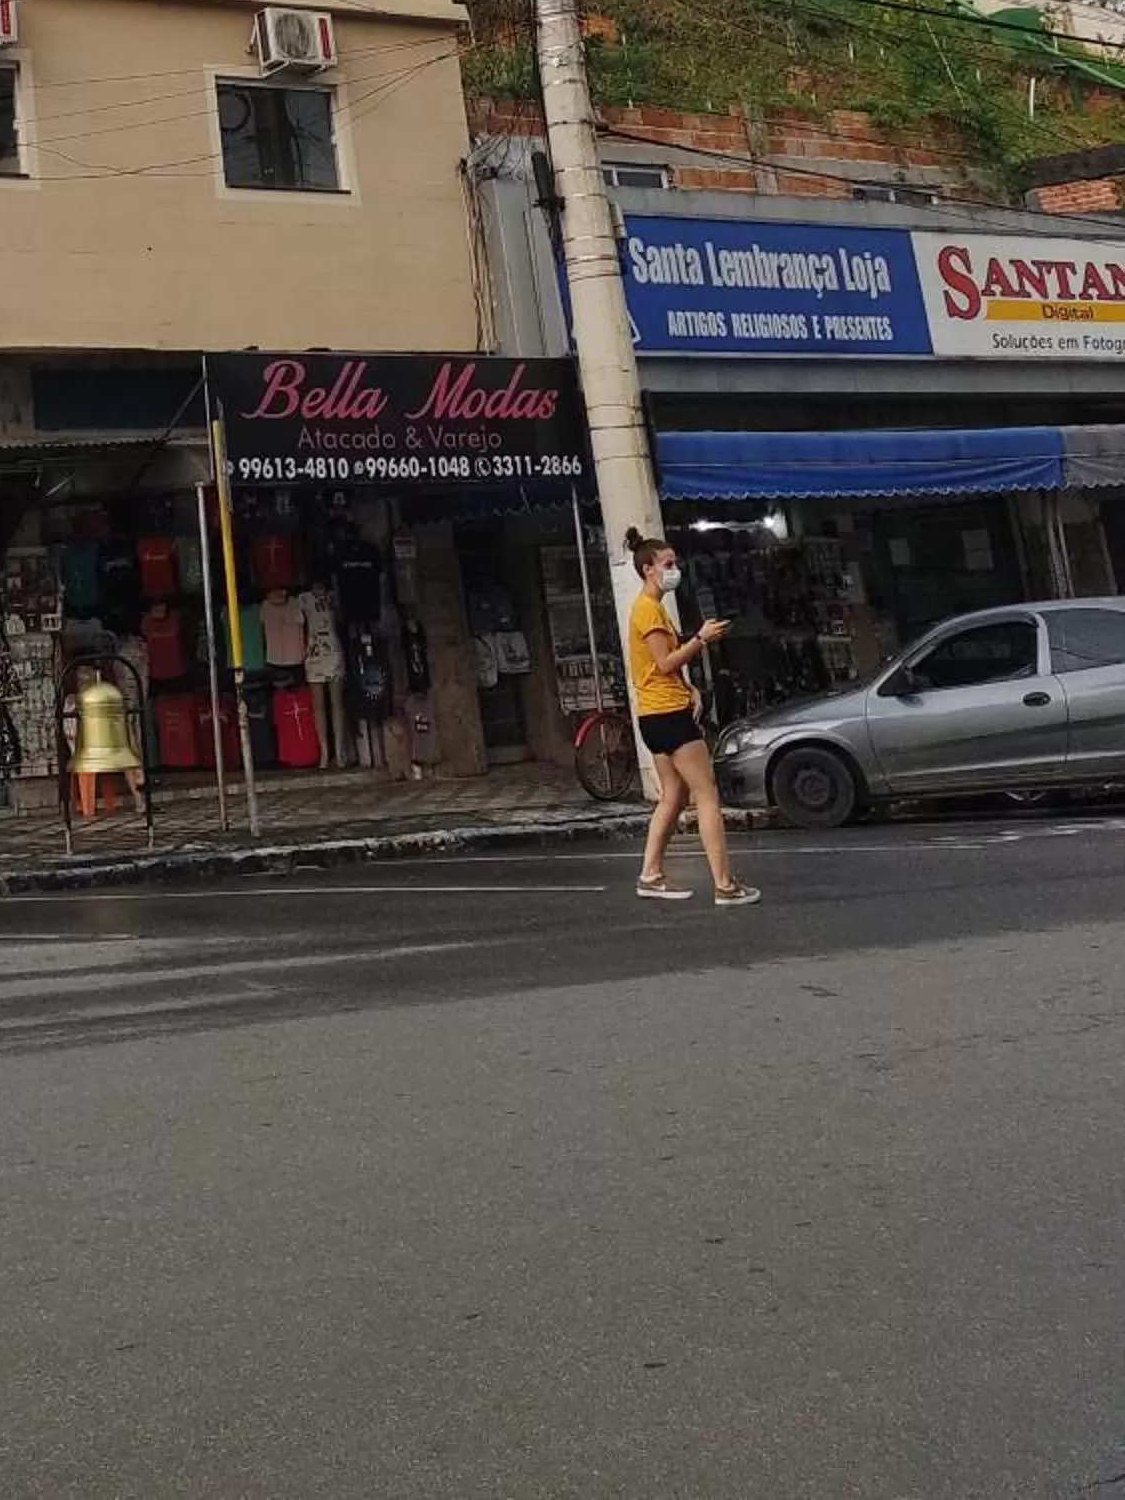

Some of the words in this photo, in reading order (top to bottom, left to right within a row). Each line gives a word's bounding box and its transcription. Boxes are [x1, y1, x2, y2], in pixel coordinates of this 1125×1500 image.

[629, 235, 705, 286] Santa
[705, 241, 838, 298] Lembrança
[840, 247, 892, 298] Loja
[667, 310, 728, 337] ARTIGOS
[731, 312, 808, 339] RELIGIOSOS
[812, 314, 822, 337] E
[824, 314, 893, 341] PRESENTES
[1042, 303, 1094, 321] Digital
[992, 332, 1053, 353] Soluções
[1058, 336, 1079, 349] em
[240, 358, 388, 420] Bella
[404, 360, 560, 420] Modas
[297, 426, 396, 451] Atacado
[404, 426, 424, 449] &
[427, 426, 503, 454] Varejo
[238, 456, 349, 481] 99613-4810
[365, 456, 470, 478] 99660-1048
[492, 454, 583, 477] 3311-2866
